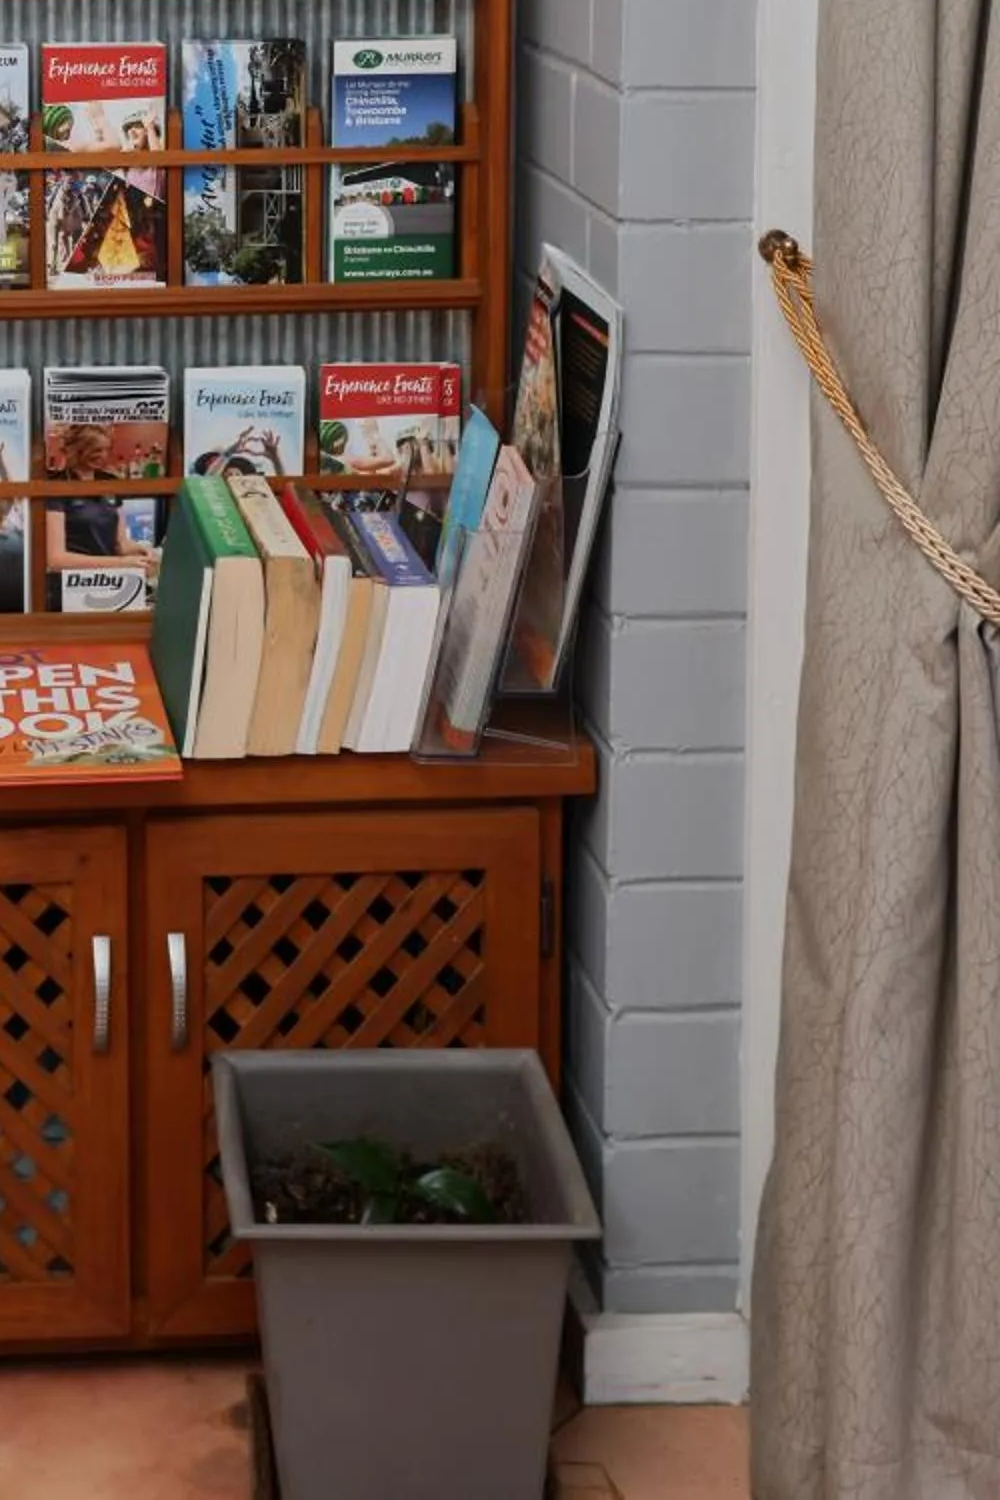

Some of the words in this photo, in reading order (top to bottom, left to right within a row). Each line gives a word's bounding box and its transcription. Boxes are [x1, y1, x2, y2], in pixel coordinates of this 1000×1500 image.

[49, 57, 117, 85] Experience
[119, 55, 158, 77] Events
[344, 245, 382, 255] Brisbane
[393, 244, 436, 254] Chinchilla
[325, 374, 391, 402] Experience
[393, 373, 435, 395] Events
[197, 388, 256, 412] Experience
[259, 388, 296, 407] Events
[66, 573, 124, 591] Dalby
